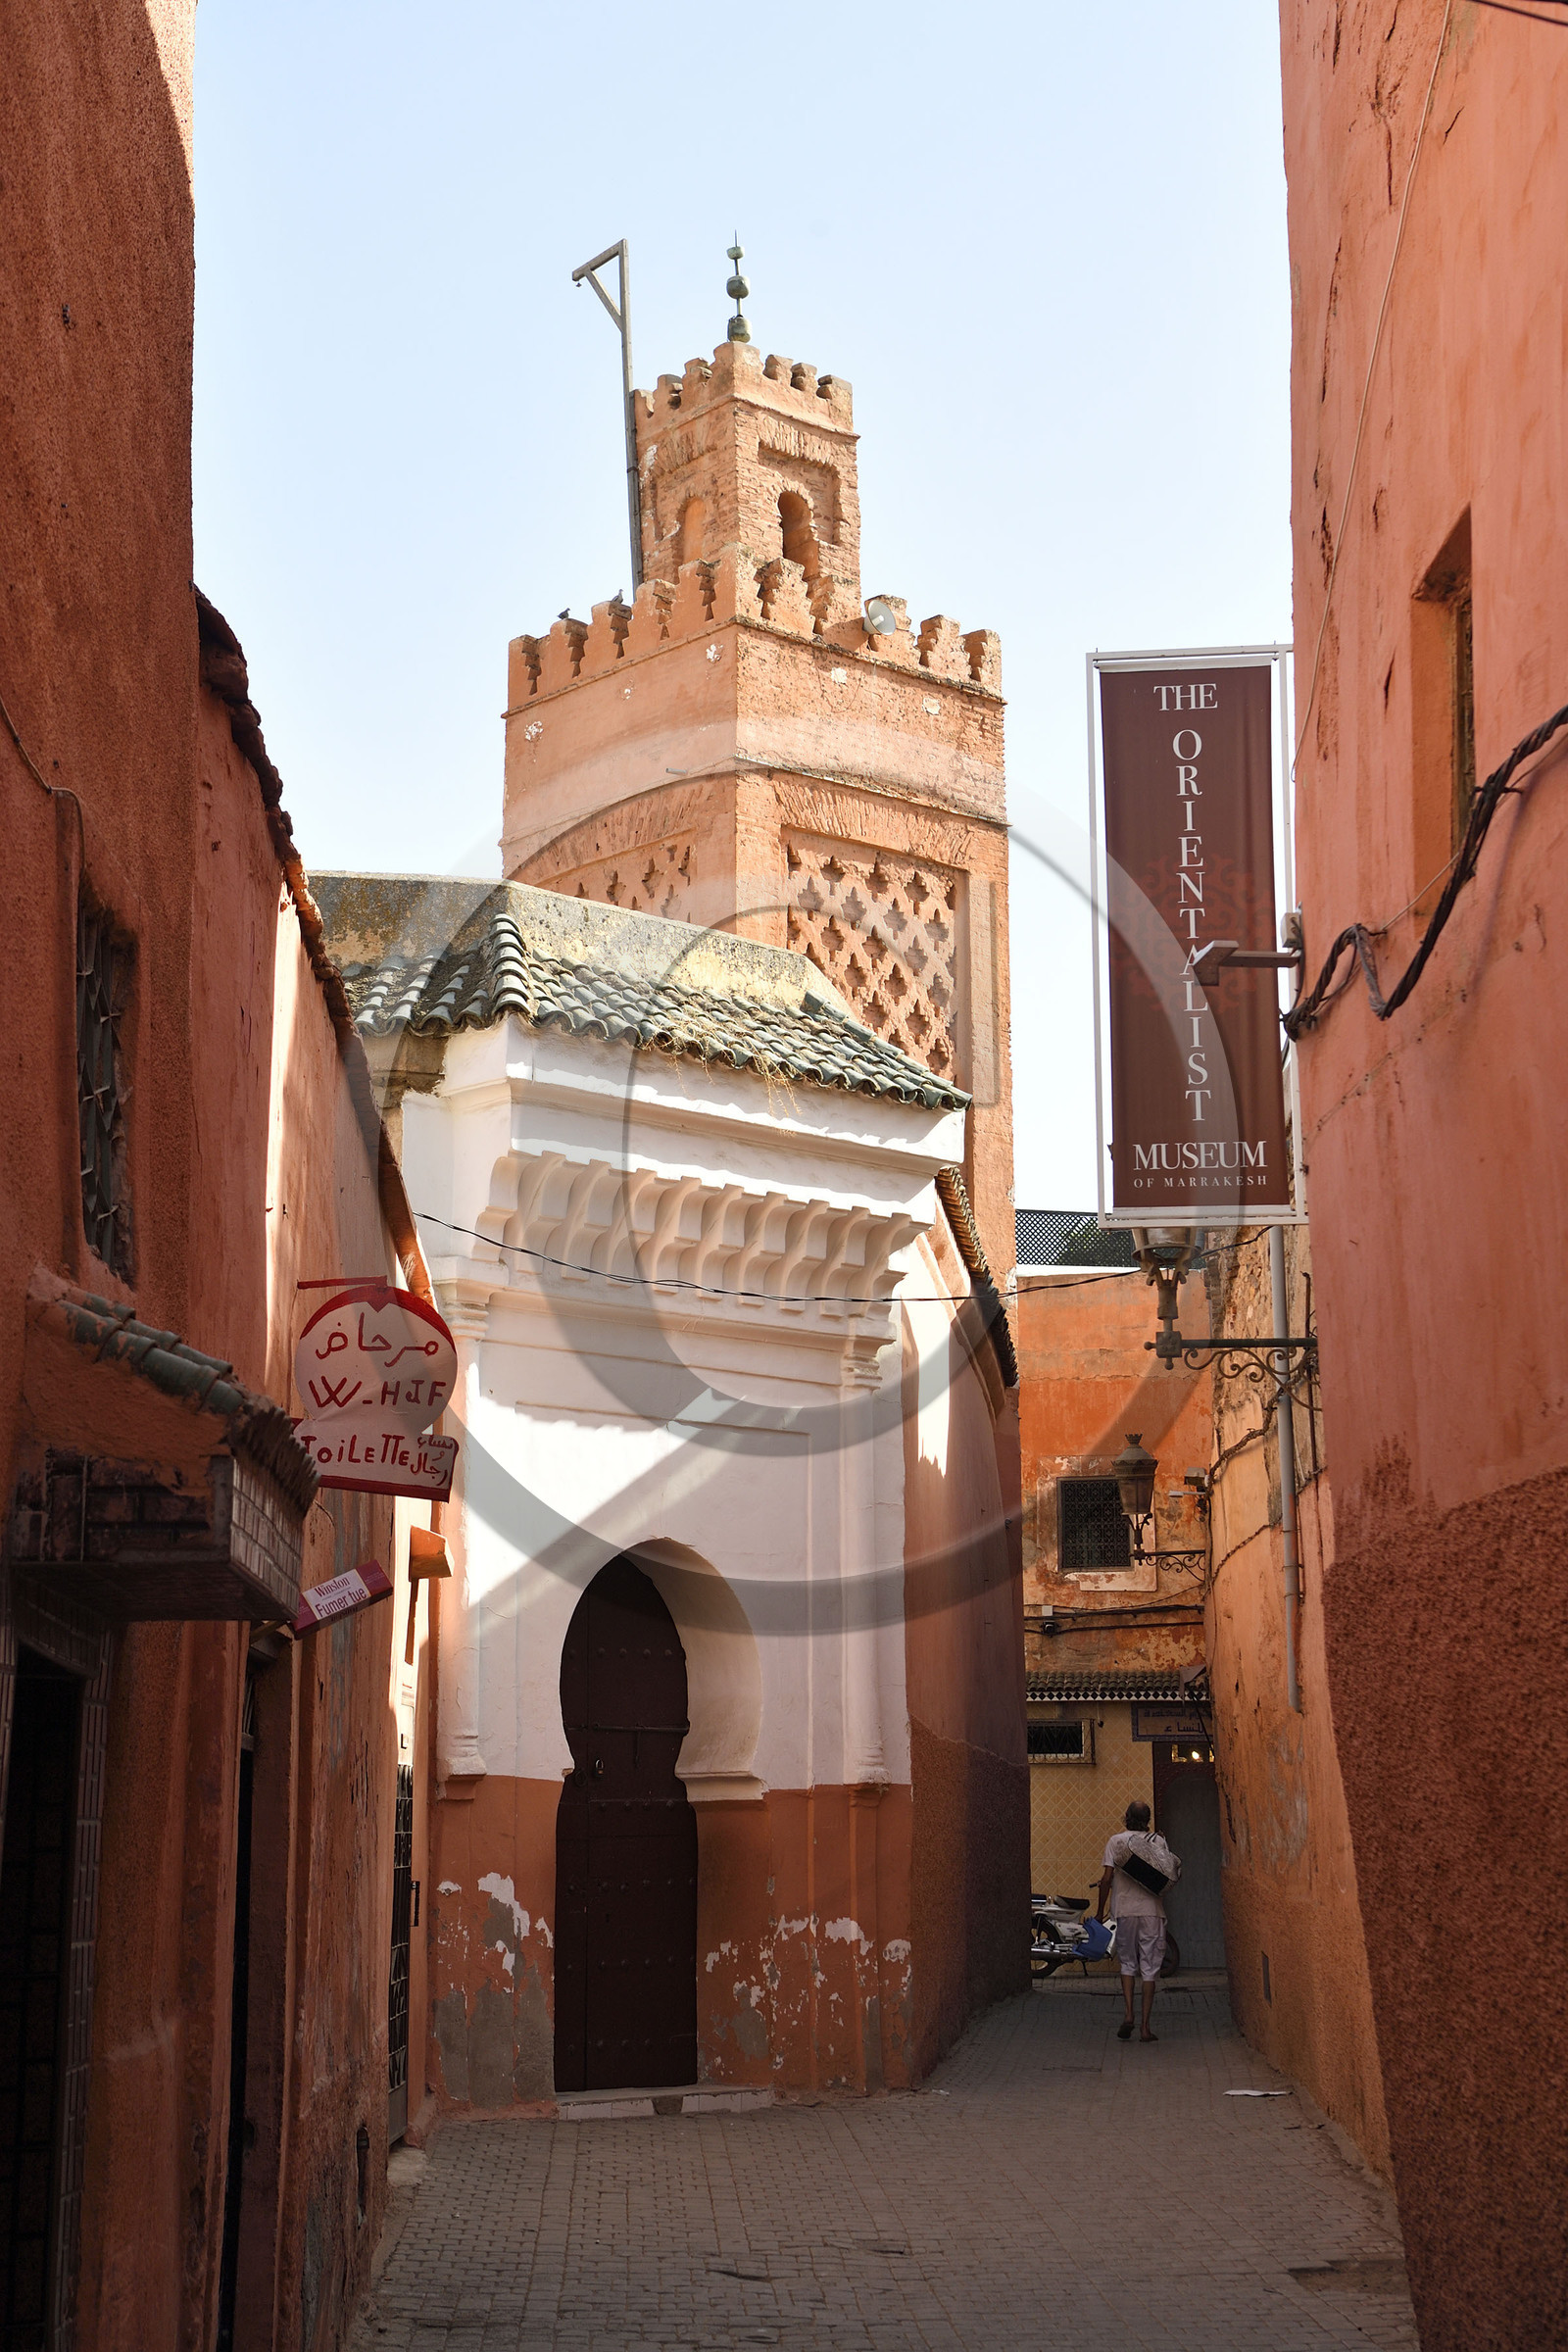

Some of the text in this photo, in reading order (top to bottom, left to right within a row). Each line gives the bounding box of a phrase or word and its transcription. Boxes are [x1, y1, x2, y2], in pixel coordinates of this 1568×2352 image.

[1153, 683, 1218, 711] THE
[1172, 728, 1212, 1122] ORIENTALIST
[1133, 1141, 1268, 1170] MUSEUM
[1134, 1175, 1267, 1188] OF MARRAKESH
[316, 1311, 439, 1367] مرحاض
[315, 1578, 351, 1597] Winston
[315, 1595, 349, 1617] Fumer
[348, 1588, 368, 1603] tue
